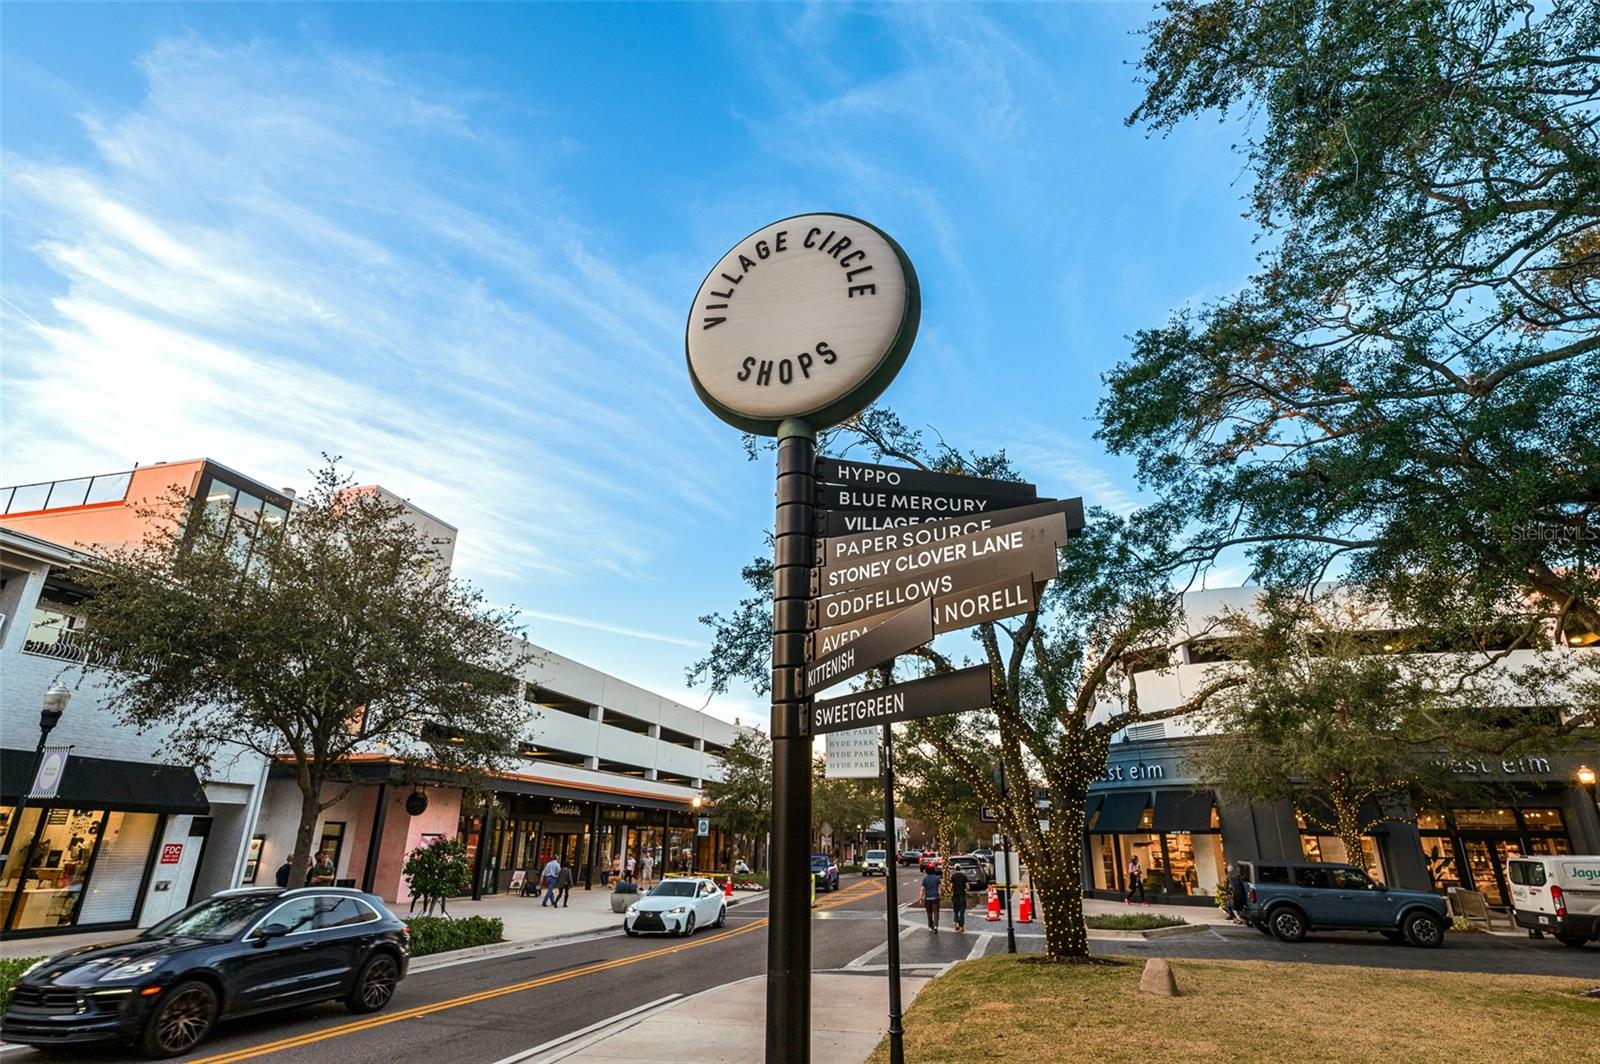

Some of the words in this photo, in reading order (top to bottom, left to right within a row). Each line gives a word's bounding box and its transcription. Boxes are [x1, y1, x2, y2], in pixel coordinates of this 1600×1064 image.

[703, 231, 788, 330] VILLAGE
[803, 227, 876, 298] CIRCLE
[737, 341, 837, 386] SHOPS
[838, 465, 901, 486] HYPPO
[839, 491, 887, 509] BLUE
[891, 494, 988, 512] MERCURY
[836, 534, 897, 558] PAPER
[903, 519, 992, 547] SOURCE
[844, 517, 920, 531] VILLAGE
[828, 559, 892, 587] STONEY
[895, 543, 967, 572] CLOVER
[972, 531, 1024, 556] LANE
[826, 575, 953, 619] ODDFELLOWS
[945, 584, 1028, 623] NORELL
[807, 648, 855, 688] KITTENISH
[815, 692, 905, 727] SWEETGREEN
[854, 739, 874, 747] PARK
[1091, 764, 1124, 781] st
[164, 845, 182, 855] FDC
[1571, 866, 1600, 881] Jagu
